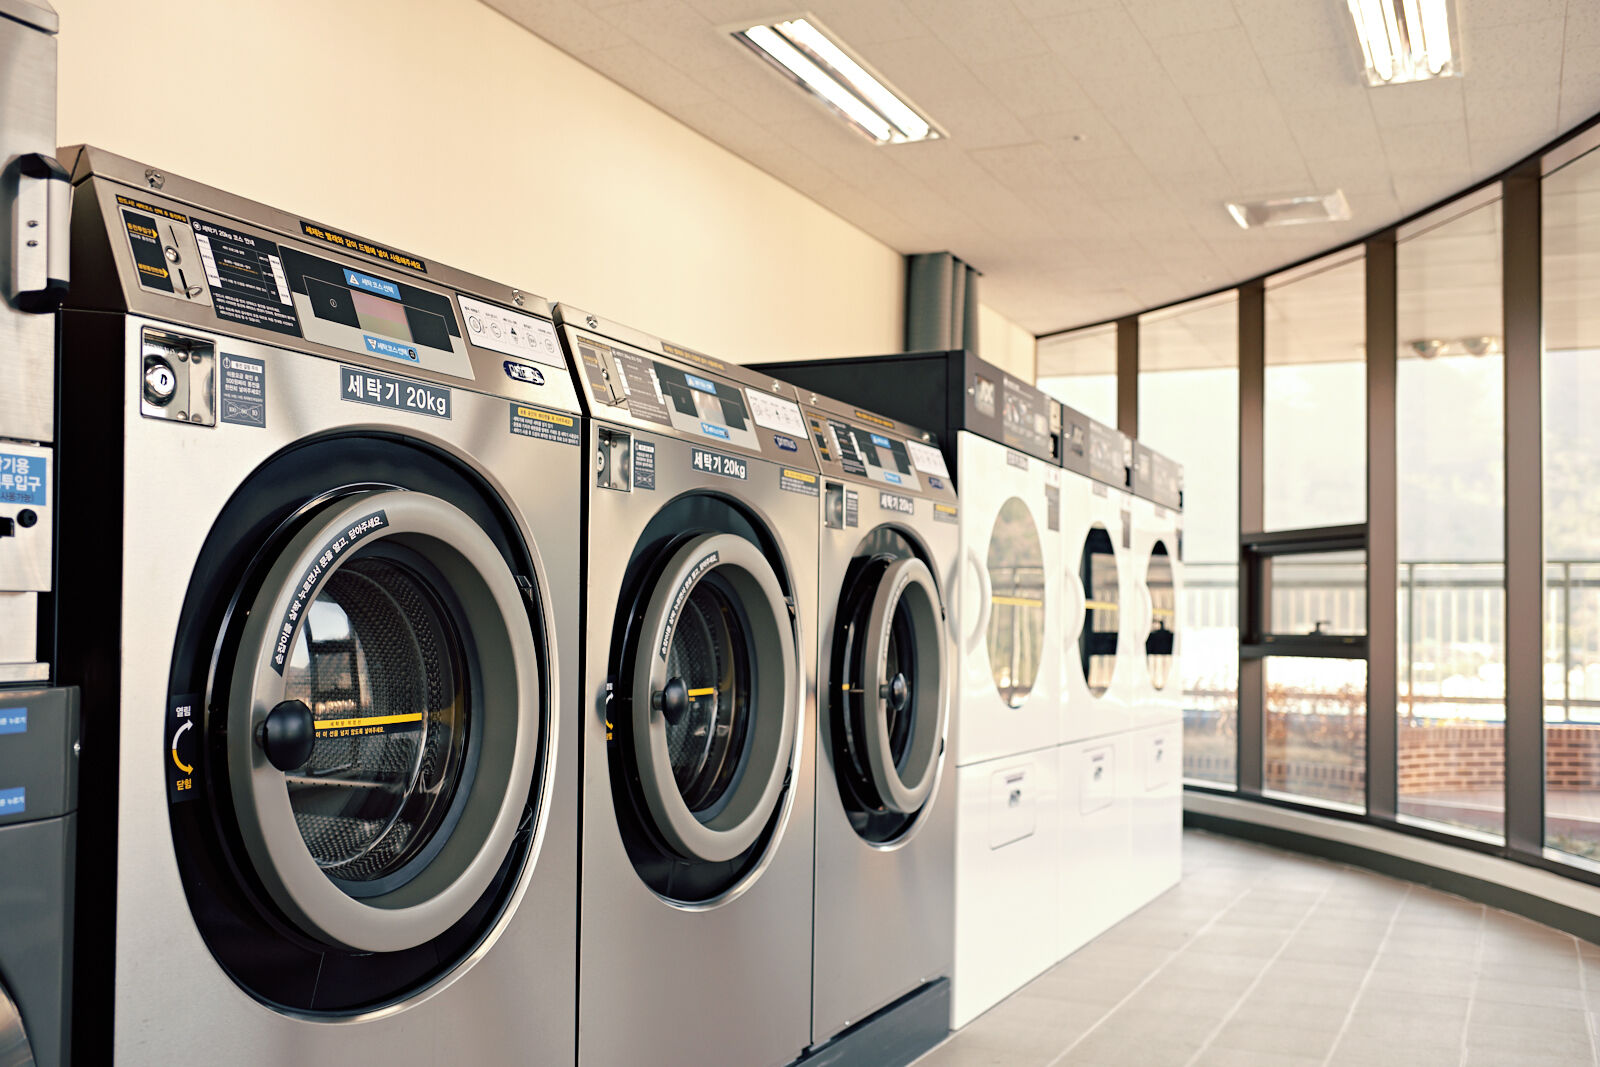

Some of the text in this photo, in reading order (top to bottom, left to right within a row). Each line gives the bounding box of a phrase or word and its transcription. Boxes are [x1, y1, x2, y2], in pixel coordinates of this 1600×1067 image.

[347, 374, 446, 416] 세탁기 20kg
[0, 456, 30, 474] 기용
[694, 452, 745, 479] 세탁기 20kg
[0, 474, 41, 492] 투입구
[881, 494, 899, 510] 세탁기
[276, 516, 383, 665] 손잡이를 살짝 누르면서 문을 열고, 닫아주세요.
[176, 705, 191, 718] 열림
[176, 778, 192, 791] 닫힘
